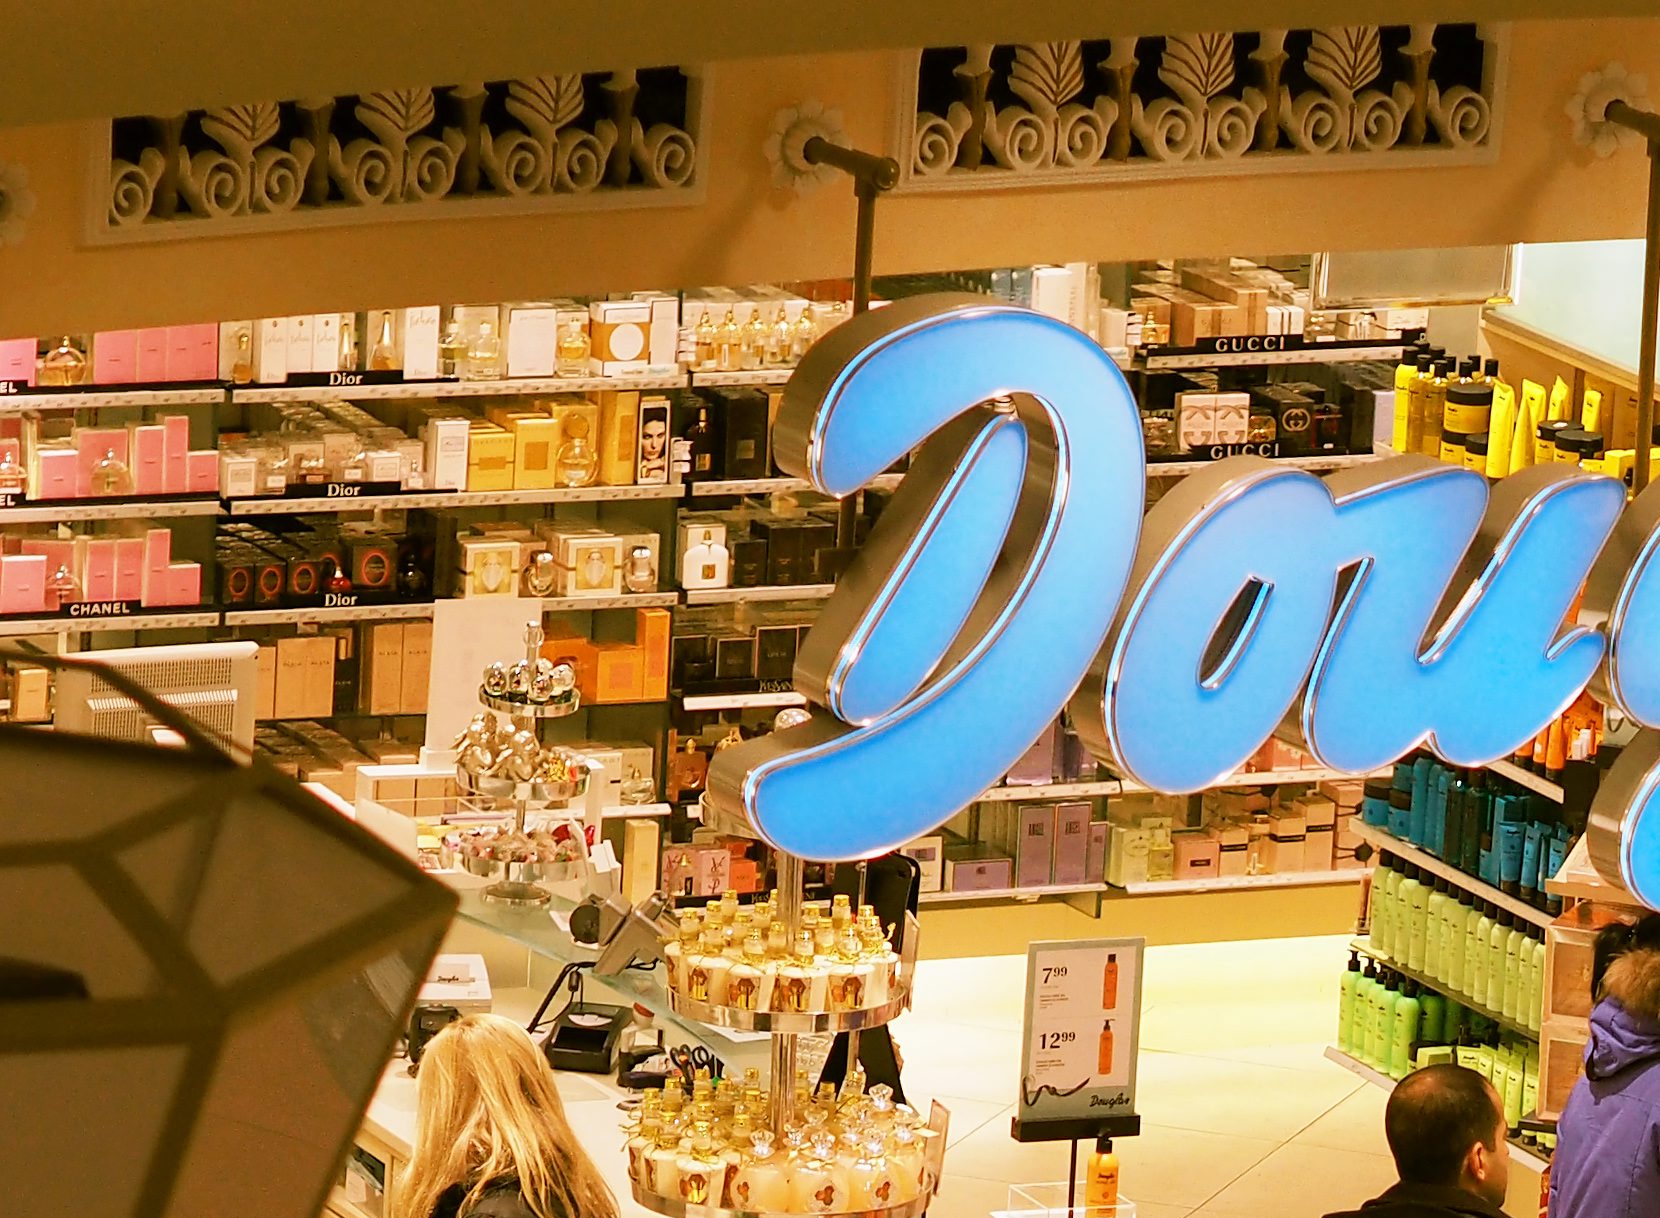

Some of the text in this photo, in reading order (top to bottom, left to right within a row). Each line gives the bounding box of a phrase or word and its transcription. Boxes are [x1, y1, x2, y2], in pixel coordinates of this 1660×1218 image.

[1215, 336, 1285, 352] GUCCI
[329, 373, 363, 386] Dior
[1210, 443, 1280, 460] GUCCI
[327, 483, 361, 497] Dior
[325, 593, 358, 607] Dior
[70, 602, 130, 616] CHANEL
[1042, 967, 1068, 984] 799
[1039, 1032, 1076, 1049] 1299
